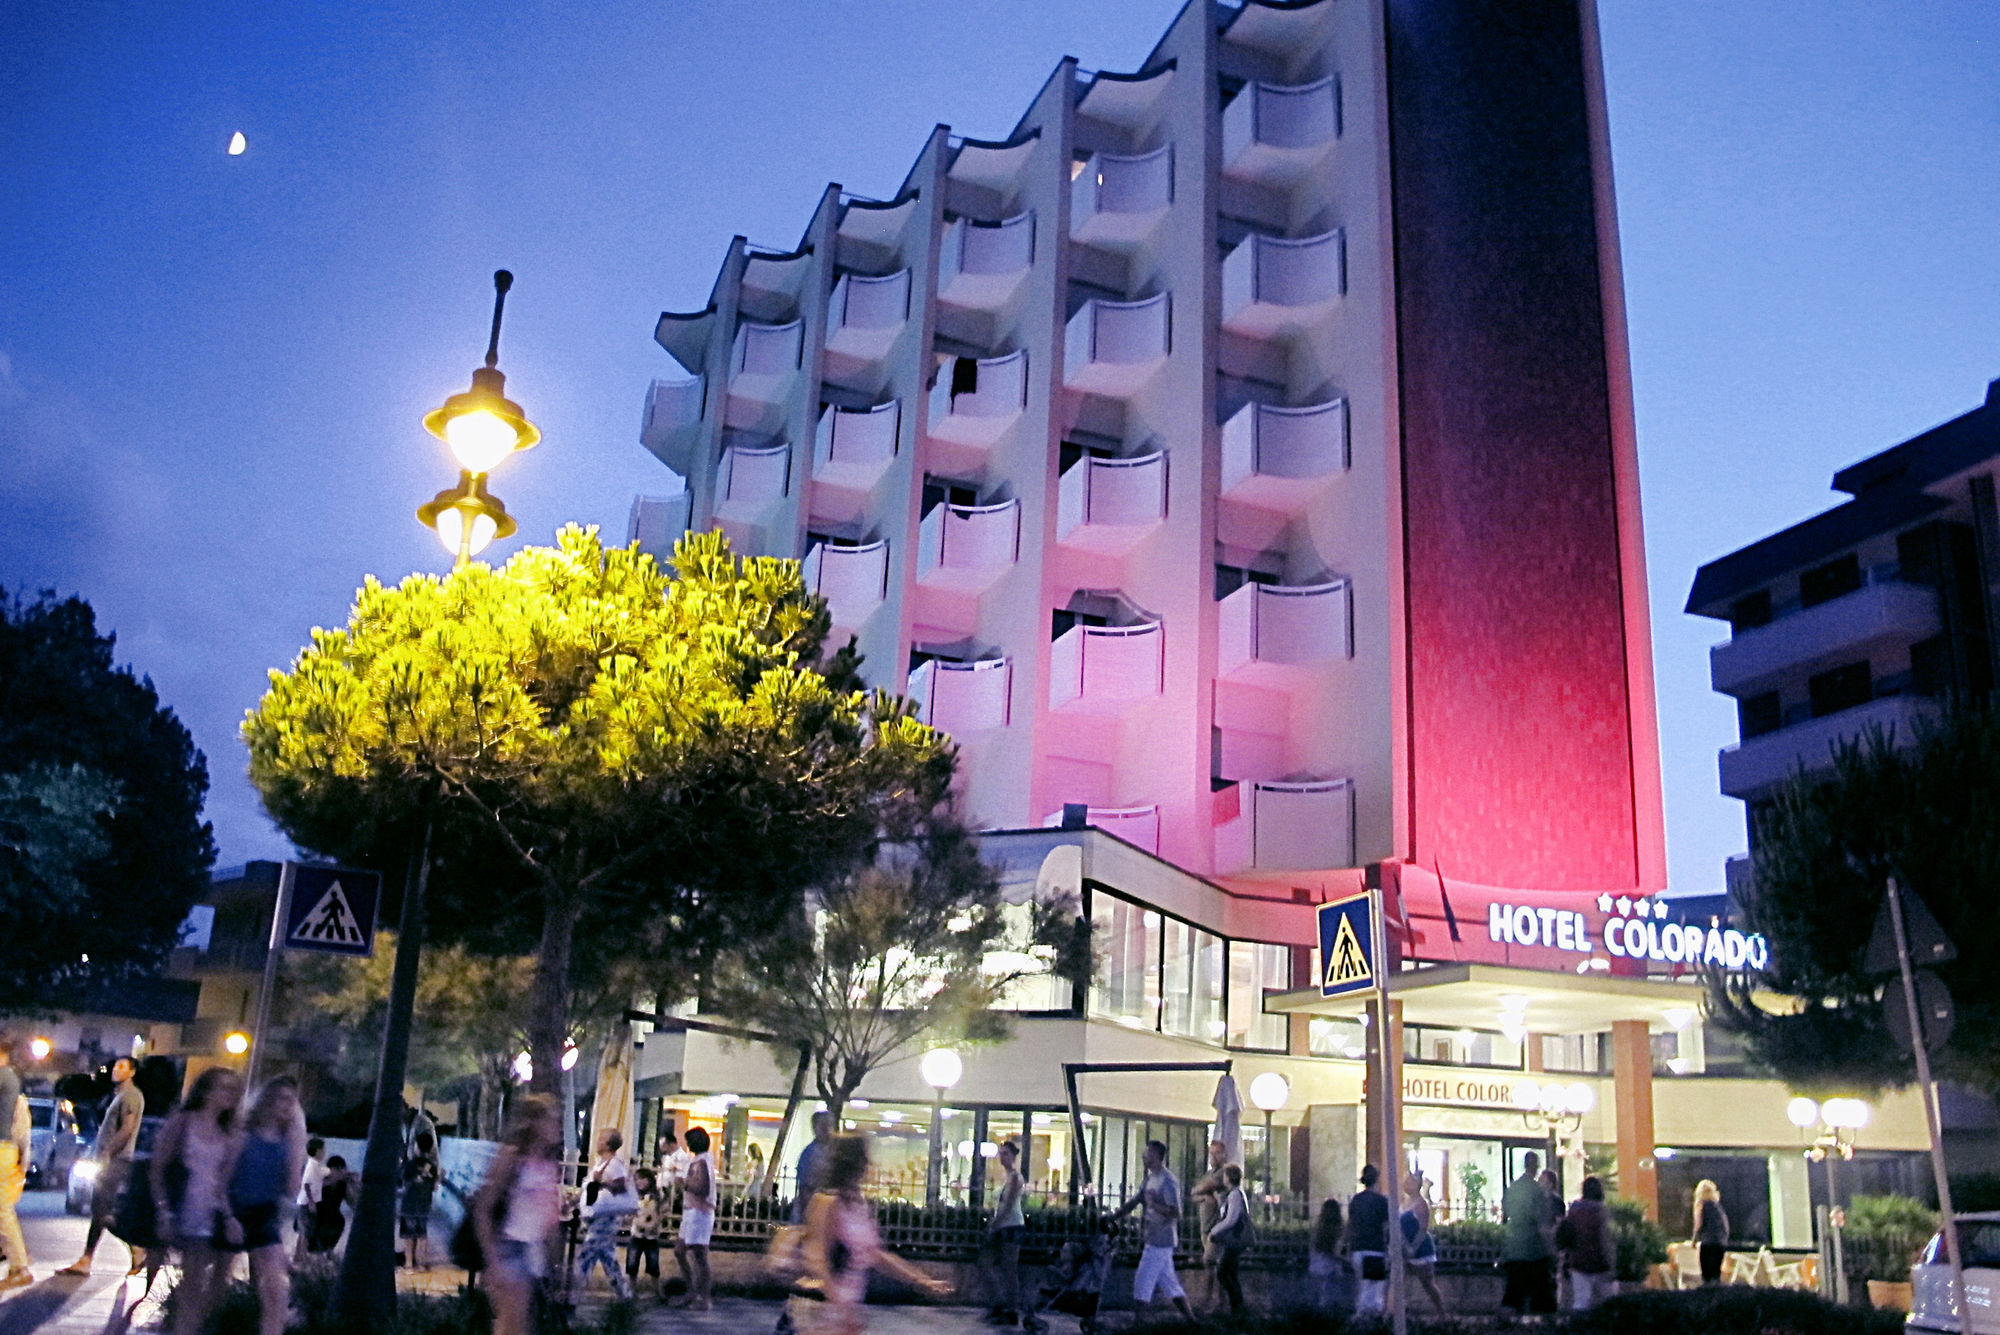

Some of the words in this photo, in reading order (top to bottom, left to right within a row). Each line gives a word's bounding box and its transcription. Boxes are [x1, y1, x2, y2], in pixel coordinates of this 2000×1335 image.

[1489, 902, 1592, 952] HOTEL
[1603, 916, 1768, 970] COLORADO
[1402, 1078, 1451, 1100] HOTEL
[1456, 1081, 1514, 1103] COLOR
